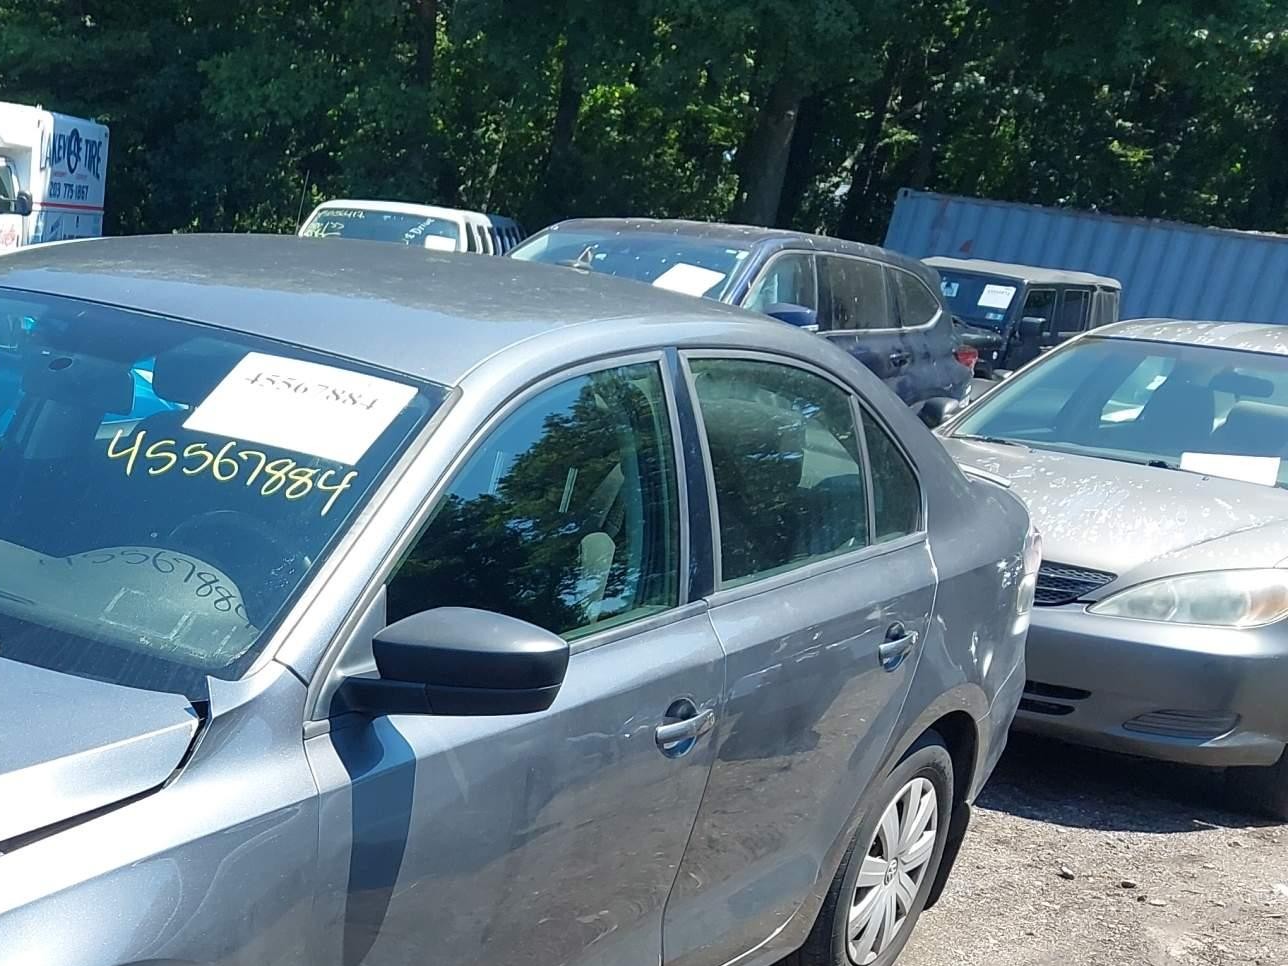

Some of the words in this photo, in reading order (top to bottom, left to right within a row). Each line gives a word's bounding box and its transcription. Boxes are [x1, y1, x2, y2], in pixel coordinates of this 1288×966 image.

[84, 138, 102, 180] TIRE
[49, 181, 61, 198] 203
[63, 182, 74, 199] 775
[245, 371, 379, 411] 45567884
[107, 429, 358, 517] 45567884
